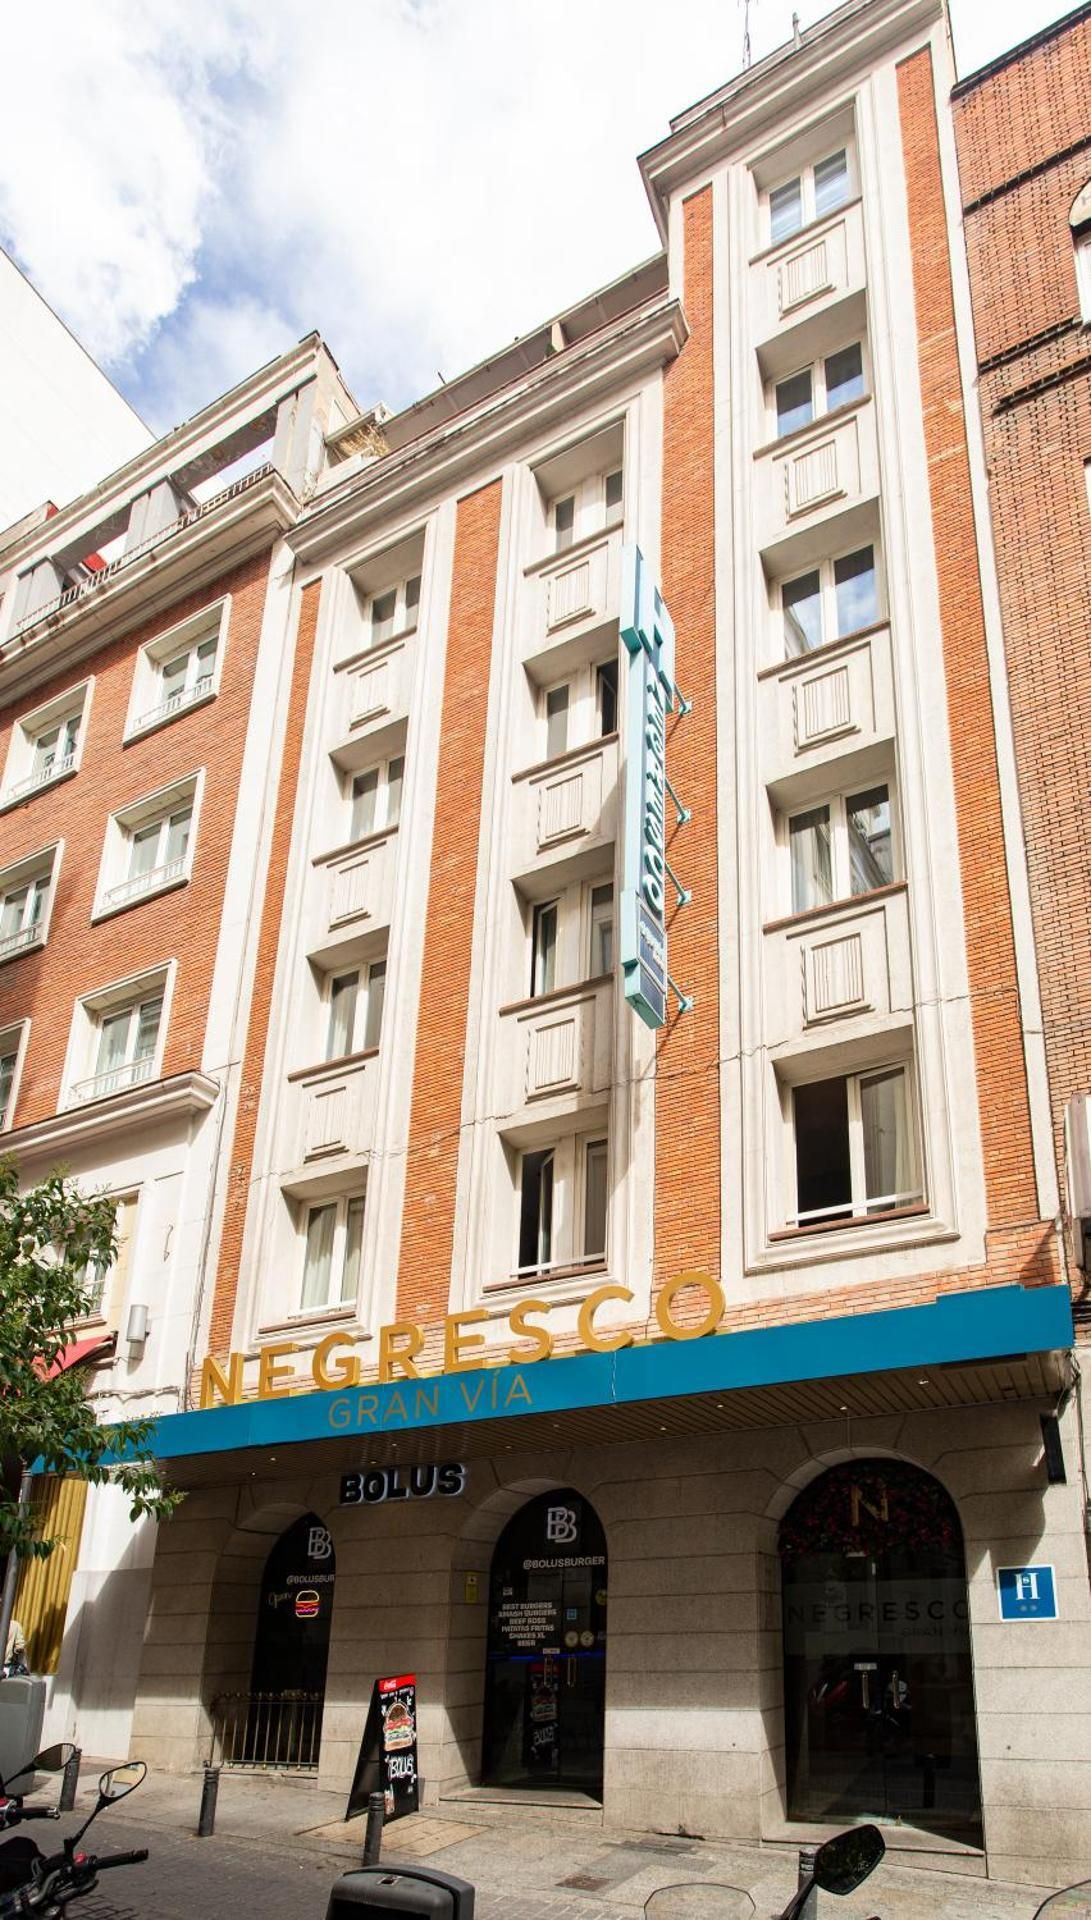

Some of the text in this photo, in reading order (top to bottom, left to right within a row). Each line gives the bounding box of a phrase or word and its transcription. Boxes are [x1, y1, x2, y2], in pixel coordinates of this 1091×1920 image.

[199, 1270, 726, 1408] NEGRESCO
[328, 1369, 533, 1429] GRAN VÍA
[339, 1463, 466, 1504] BOLUS
[851, 1485, 889, 1526] N
[523, 1556, 605, 1570] @BOLUSBURGER
